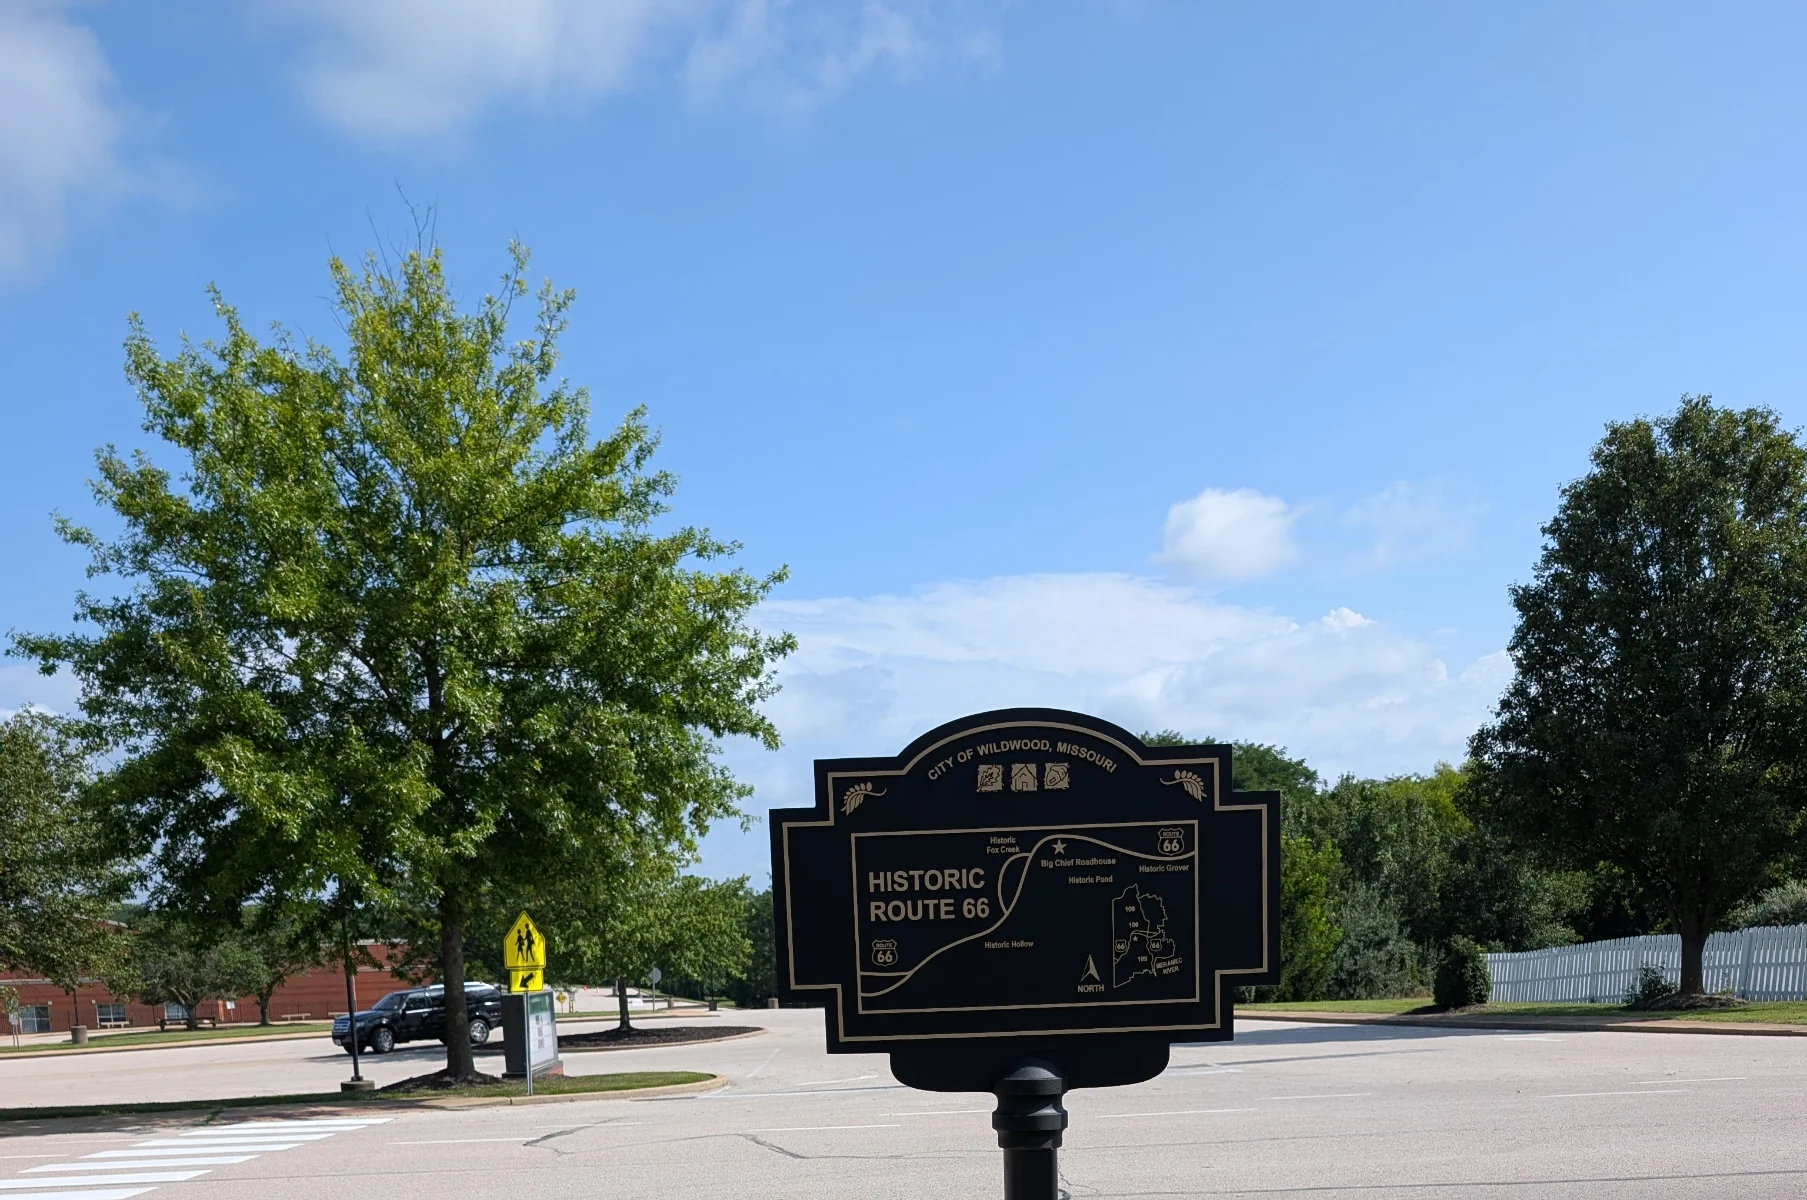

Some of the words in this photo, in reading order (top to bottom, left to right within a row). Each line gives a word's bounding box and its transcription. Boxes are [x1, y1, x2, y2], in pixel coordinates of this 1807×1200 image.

[927, 756, 954, 780] CITY
[957, 748, 975, 763] OF
[976, 739, 1053, 757] WILDWOOD,
[1056, 741, 1117, 773] MISSOURI
[990, 835, 1016, 845] Historic
[986, 846, 1000, 854] Fox
[1000, 845, 1020, 853] Creek
[1163, 839, 1180, 852] 66
[1041, 859, 1054, 868] Big
[1054, 858, 1075, 867] Chief
[1075, 857, 1116, 866] Roadhouse
[1139, 864, 1165, 873] Historic
[1166, 864, 1190, 872] Grover
[868, 867, 985, 893] HISTORIC
[1068, 875, 1094, 884] Historic
[1095, 874, 1114, 883] Pond
[869, 898, 956, 922] ROUTE
[962, 897, 990, 919] 66
[984, 940, 1010, 949] Historic
[1011, 940, 1034, 948] Hollow
[1116, 942, 1125, 950] 66
[877, 950, 893, 963] 66
[1162, 966, 1180, 975] RIVER
[1077, 984, 1104, 993] NORTH
